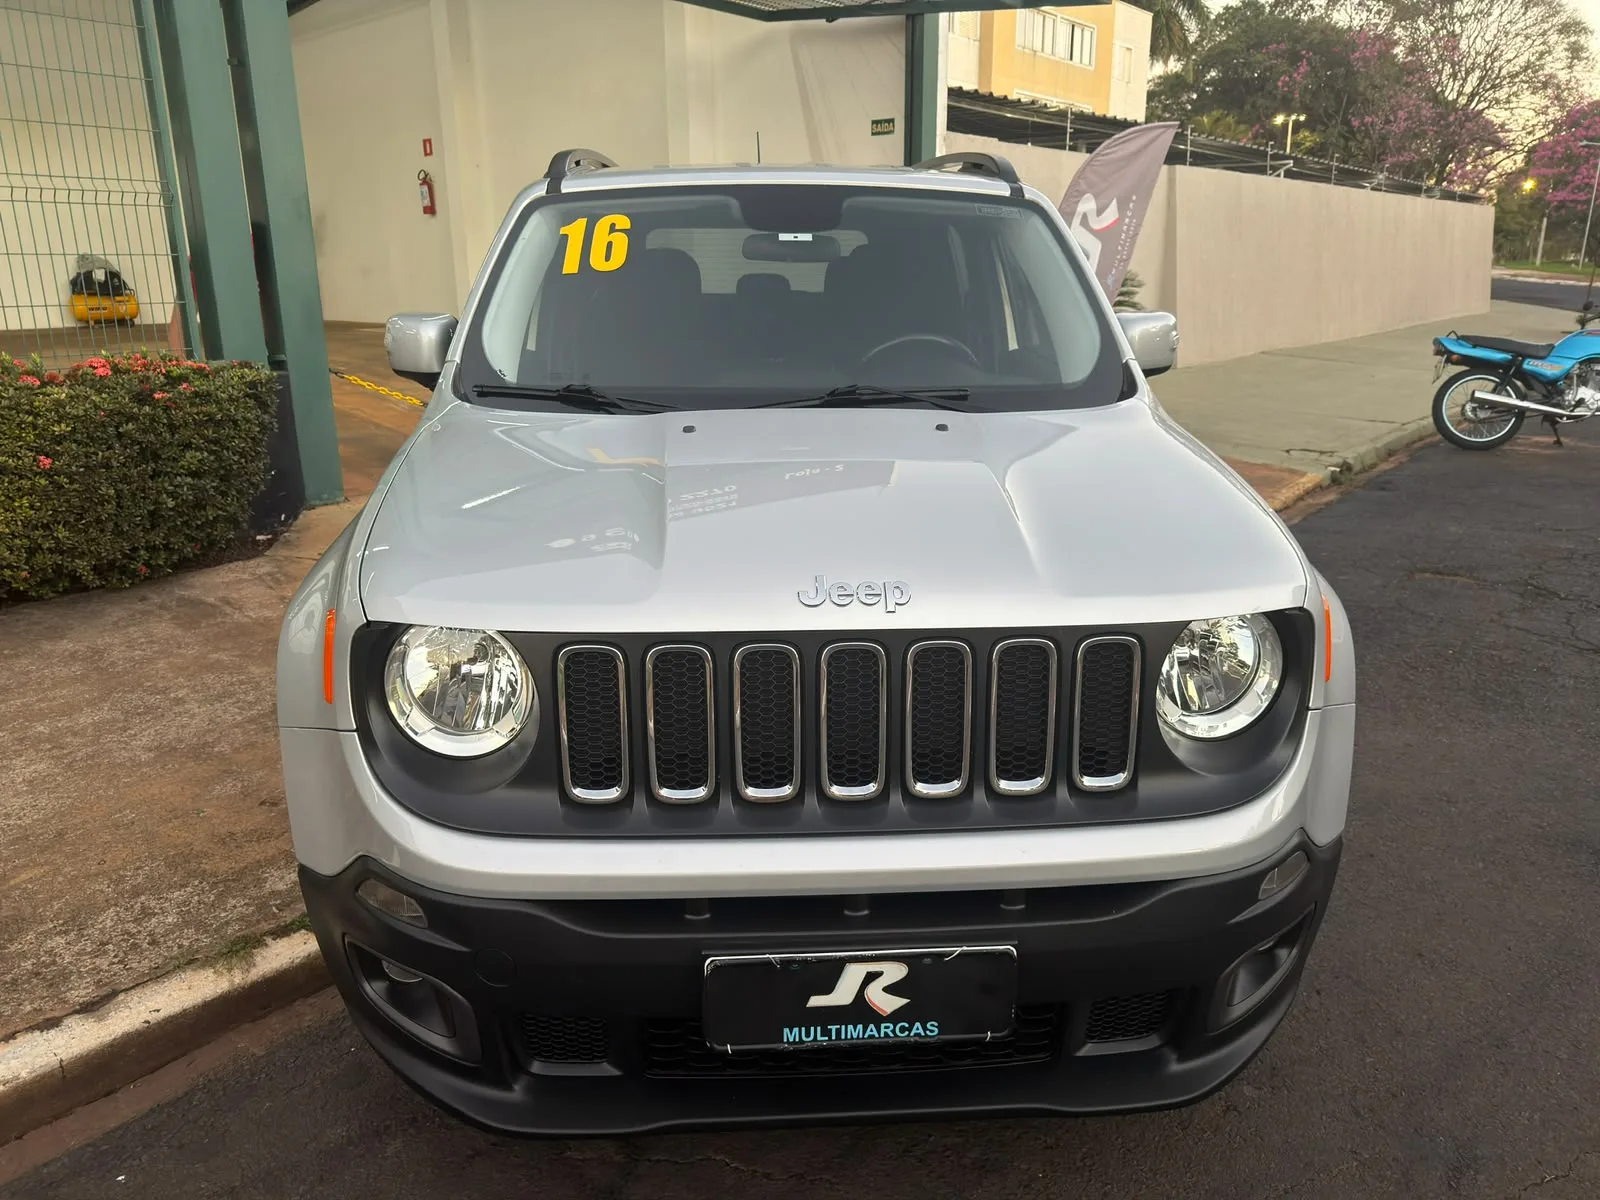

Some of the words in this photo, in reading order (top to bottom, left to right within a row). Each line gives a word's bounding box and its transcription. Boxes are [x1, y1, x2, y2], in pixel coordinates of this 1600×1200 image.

[872, 121, 894, 133] SAÍDA
[560, 214, 632, 275] 16
[797, 574, 912, 613] Jeep
[806, 961, 911, 1016] JR
[783, 1021, 939, 1043] MULTIMARCAS
